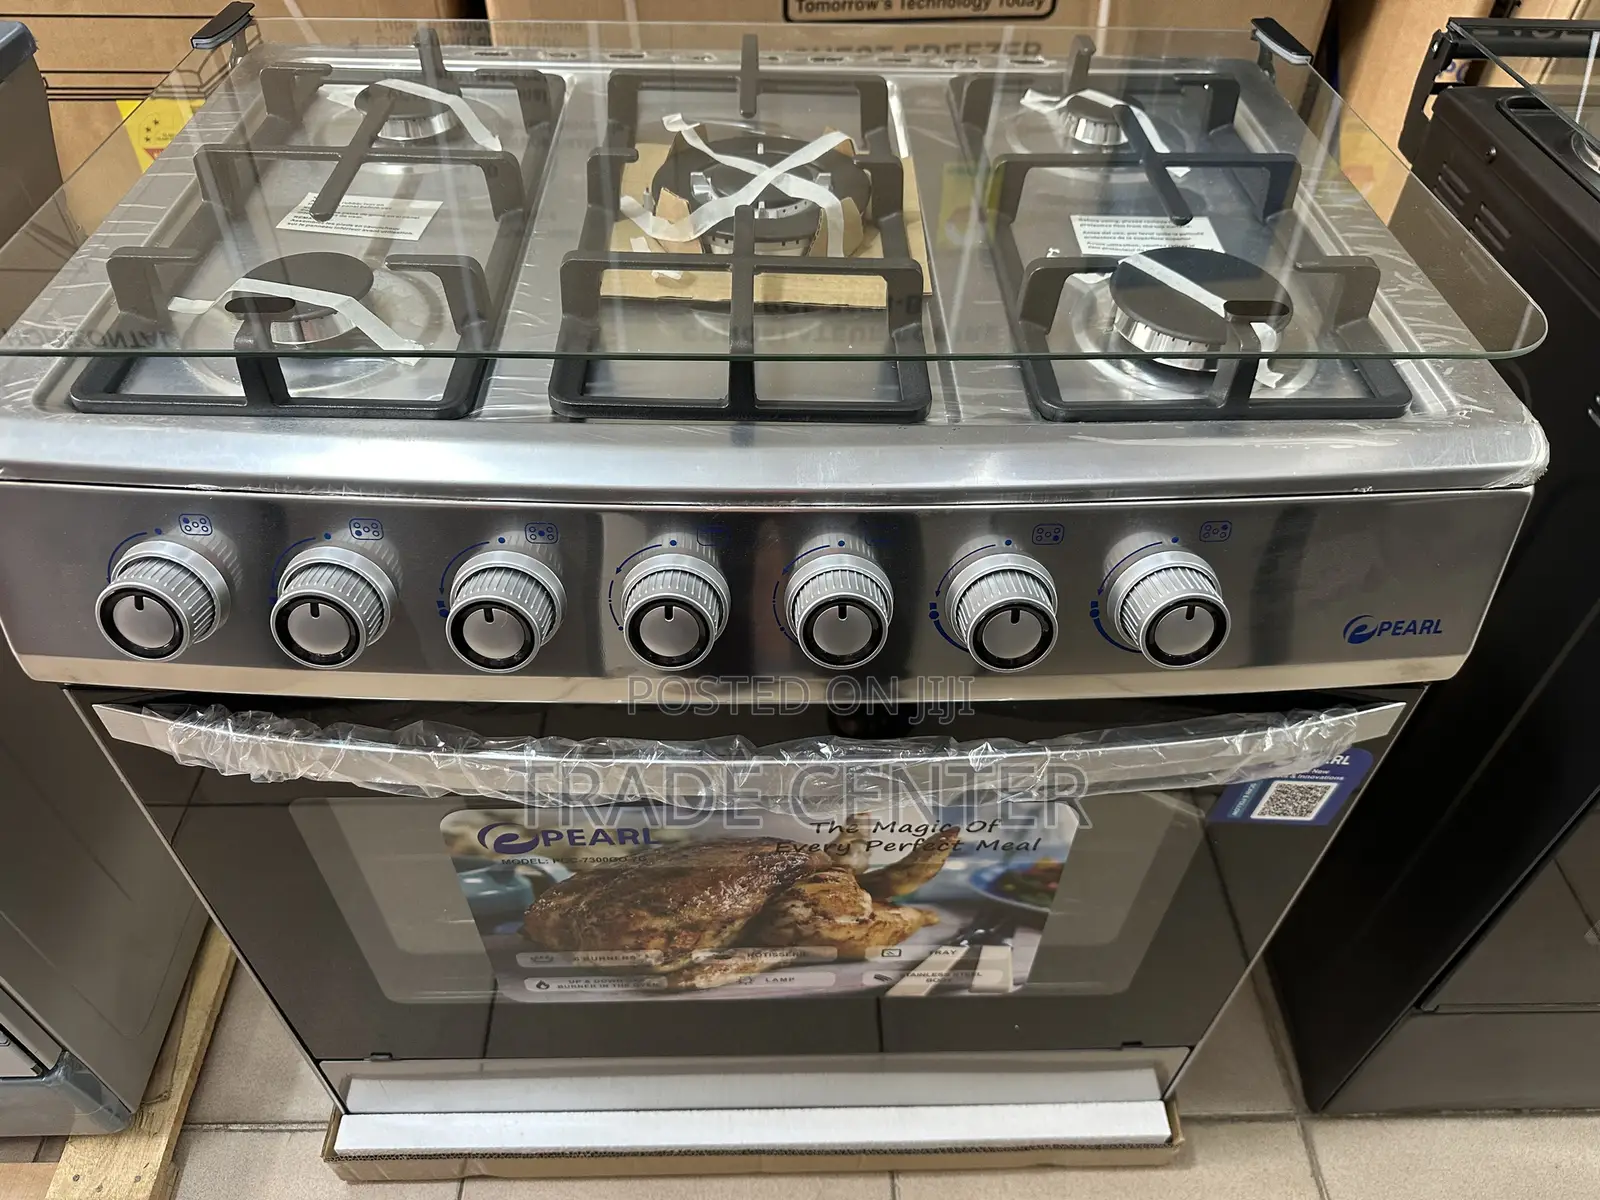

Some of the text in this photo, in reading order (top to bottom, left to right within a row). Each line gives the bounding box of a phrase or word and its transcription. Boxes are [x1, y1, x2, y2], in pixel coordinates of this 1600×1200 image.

[797, 0, 1044, 14] Tomorrow's Technology Today
[1376, 618, 1443, 637] PEARL
[541, 828, 662, 847] PEARL
[808, 819, 1002, 838] The Magic Of
[774, 837, 1042, 856] Every Perfect Meal
[500, 857, 549, 866] MODEL:
